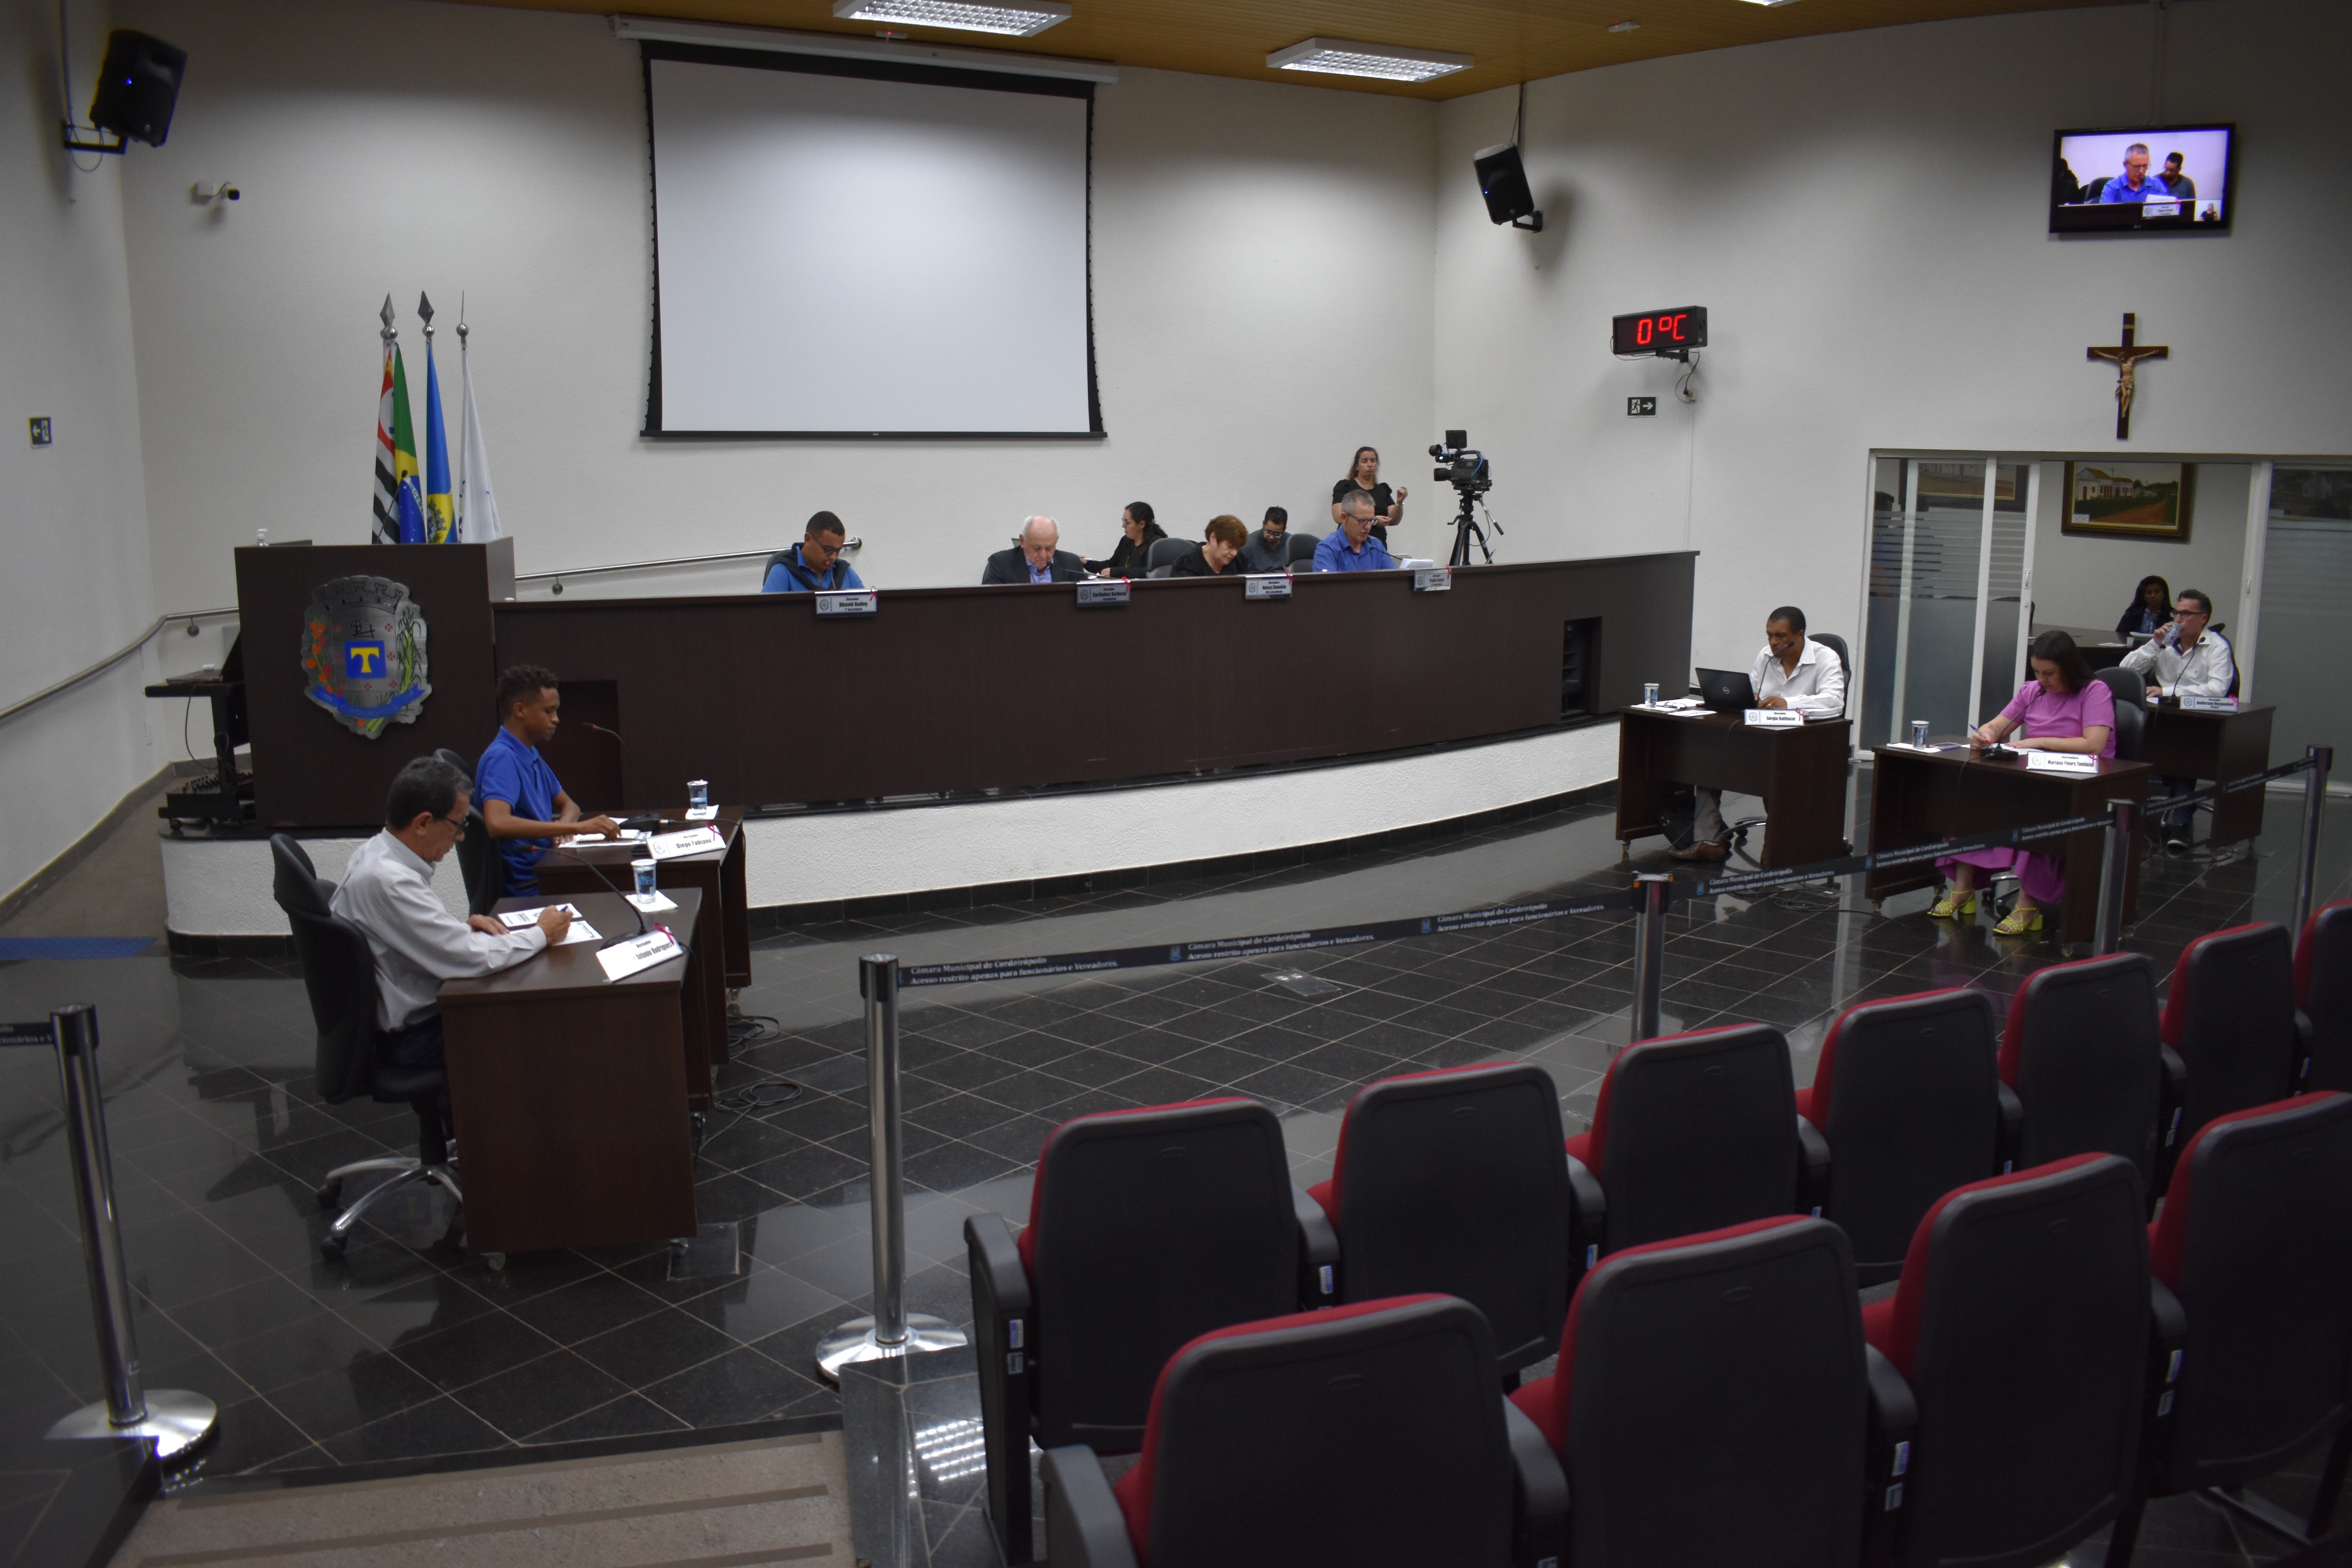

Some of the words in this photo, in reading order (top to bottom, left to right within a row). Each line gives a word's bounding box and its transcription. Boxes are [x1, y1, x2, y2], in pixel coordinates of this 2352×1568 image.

[1463, 909, 1495, 918] Municipal
[1486, 918, 1508, 926] apenas
[1216, 938, 1252, 947] Municipal
[1213, 949, 1241, 958] restrito
[1242, 947, 1267, 956] apenas
[1268, 945, 1285, 953] para
[943, 962, 982, 972] Municipal
[994, 956, 1047, 968] Cordeirópolis
[911, 977, 938, 985] Acesso
[939, 974, 969, 983] restrito
[971, 971, 999, 981] apenas
[1000, 970, 1018, 979] para
